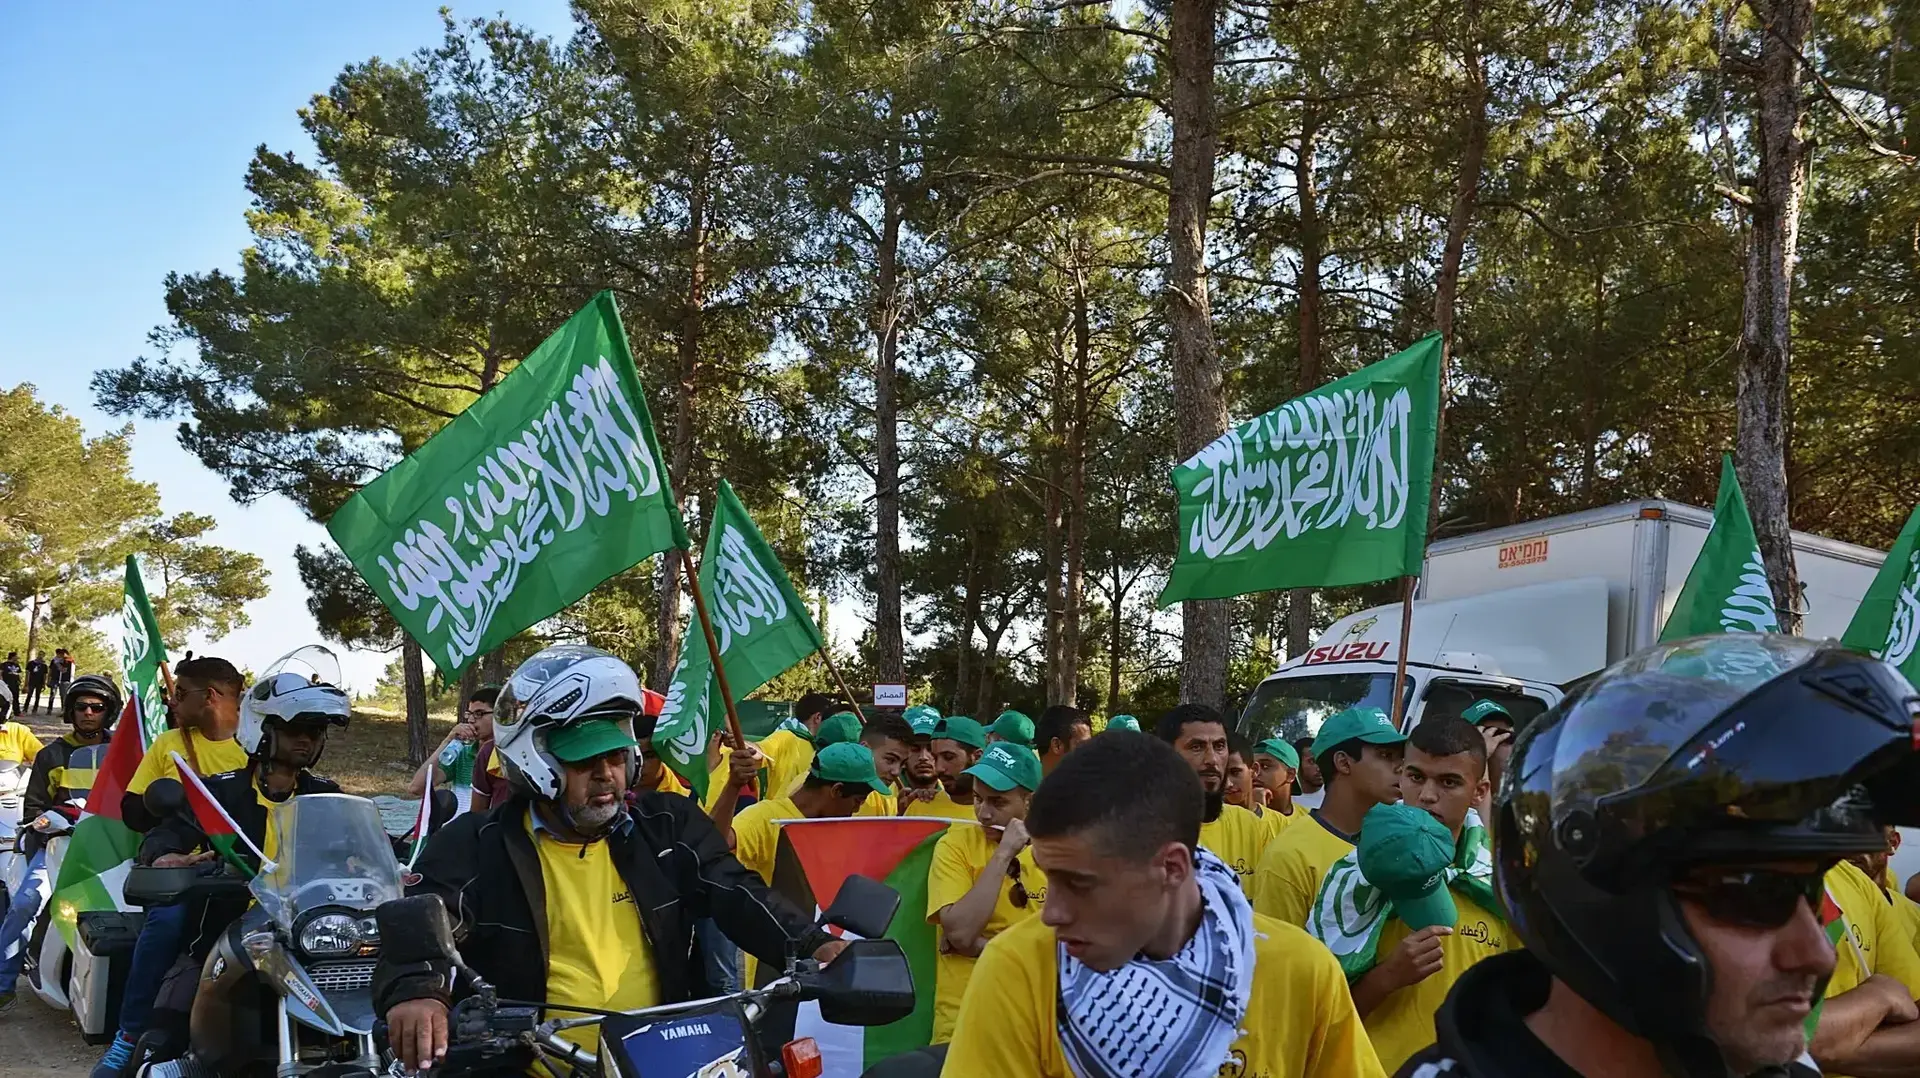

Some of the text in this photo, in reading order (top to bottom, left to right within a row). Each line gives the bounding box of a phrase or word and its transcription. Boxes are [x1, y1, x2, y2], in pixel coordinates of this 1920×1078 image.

[1499, 540, 1549, 562] נחמיאס
[1303, 641, 1390, 664] ISUZU
[876, 692, 904, 700] المصلى
[660, 1023, 712, 1041] YAMAHA
